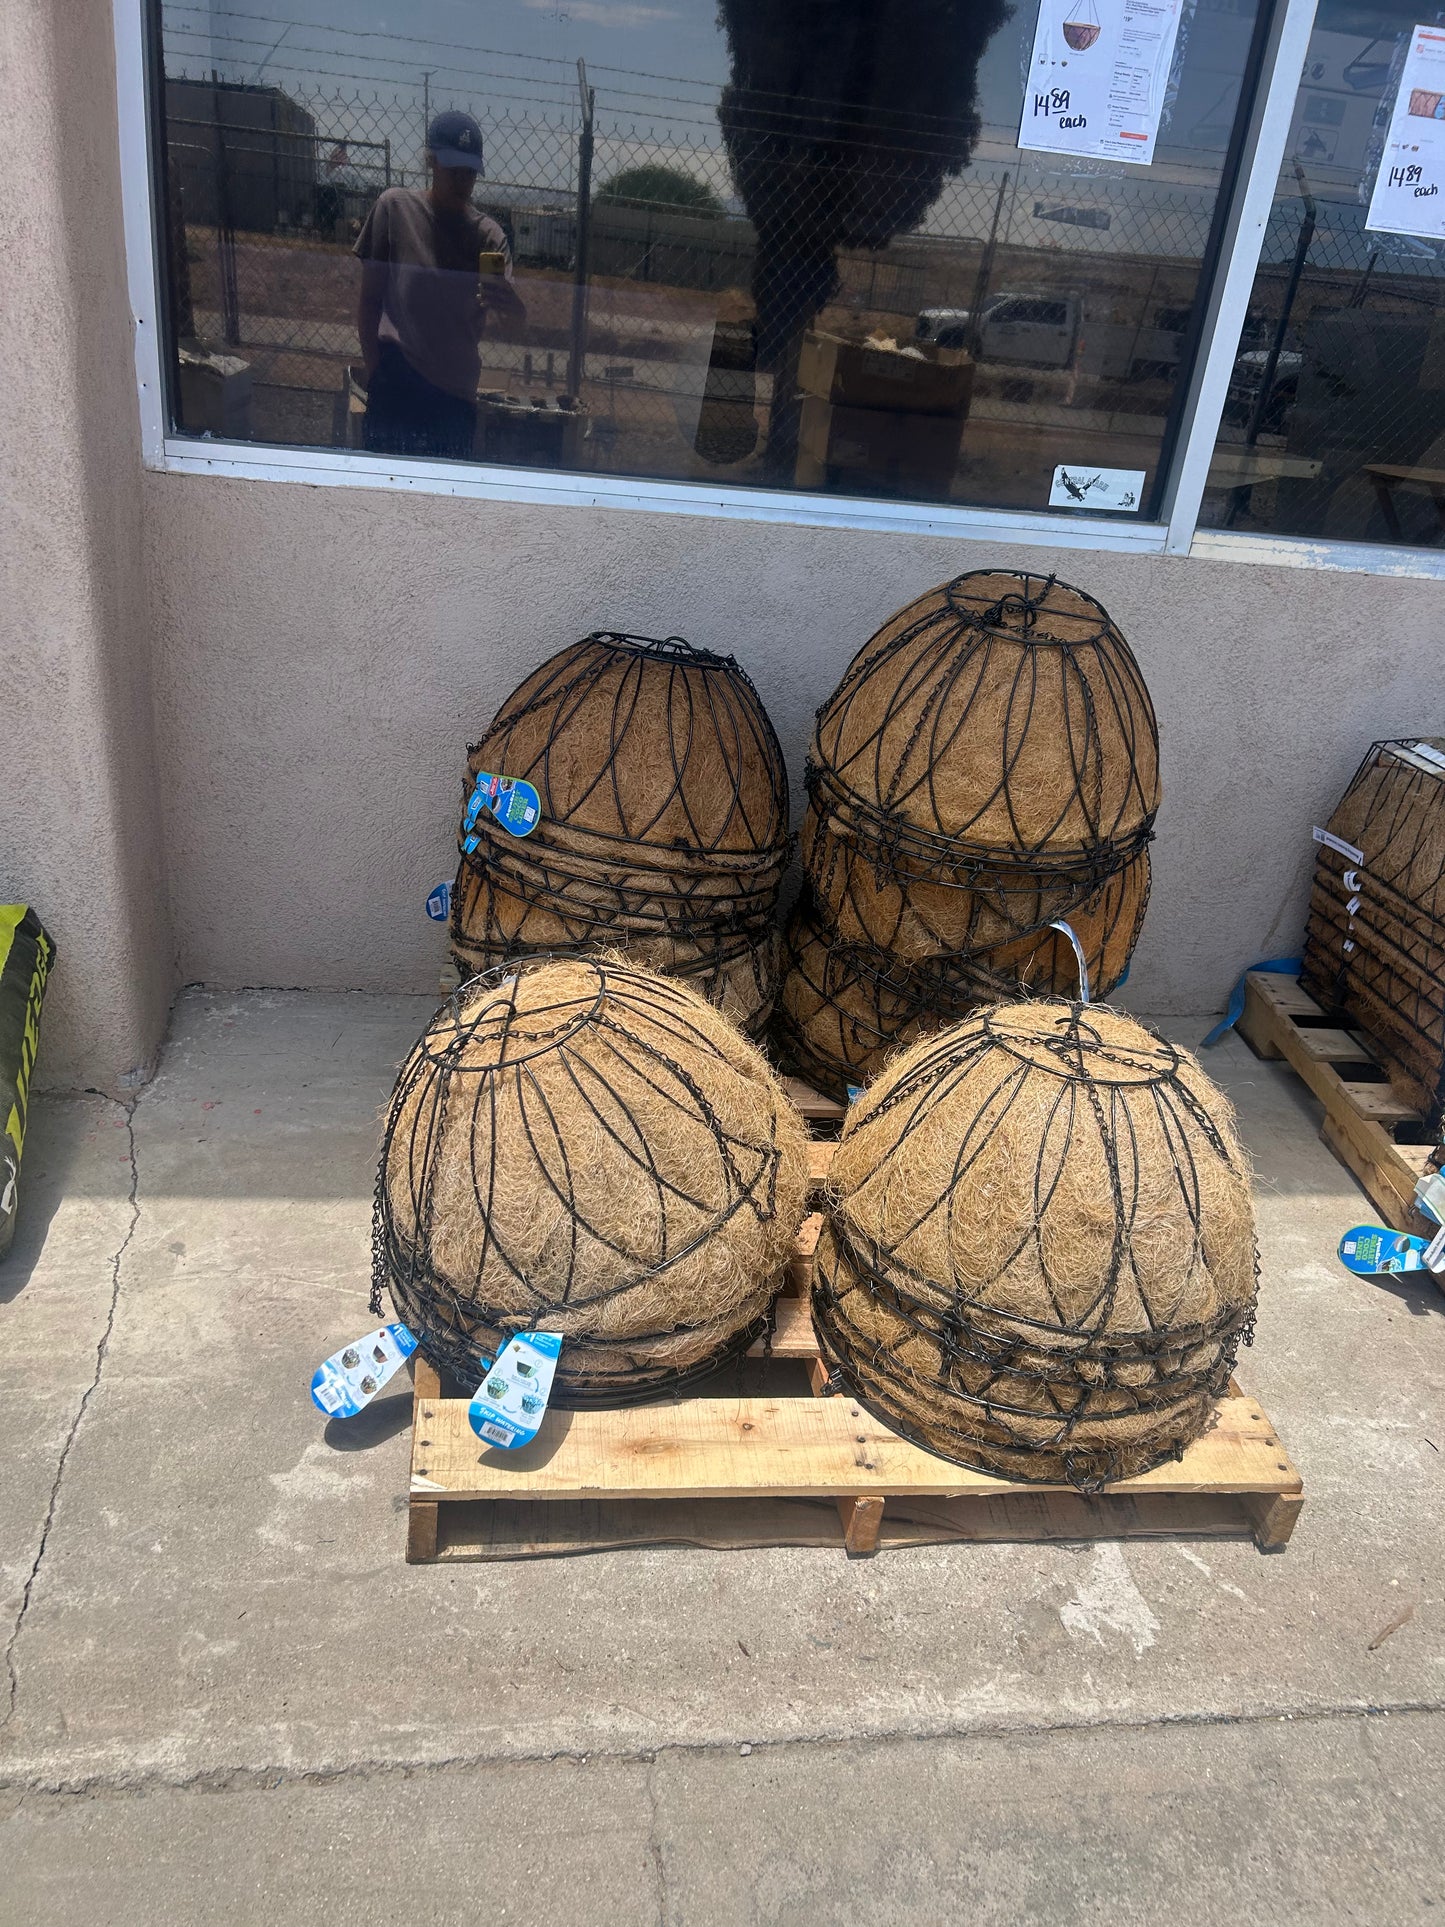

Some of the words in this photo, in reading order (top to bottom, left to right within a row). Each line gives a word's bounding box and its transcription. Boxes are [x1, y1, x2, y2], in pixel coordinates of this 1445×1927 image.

[1034, 88, 1070, 117] 1489
[1059, 114, 1087, 129] each
[1388, 164, 1423, 187] 1489
[1414, 183, 1438, 197] each
[1355, 1236, 1364, 1261] LINER
[1361, 1237, 1371, 1261] COCO
[1367, 1233, 1378, 1265] SMART
